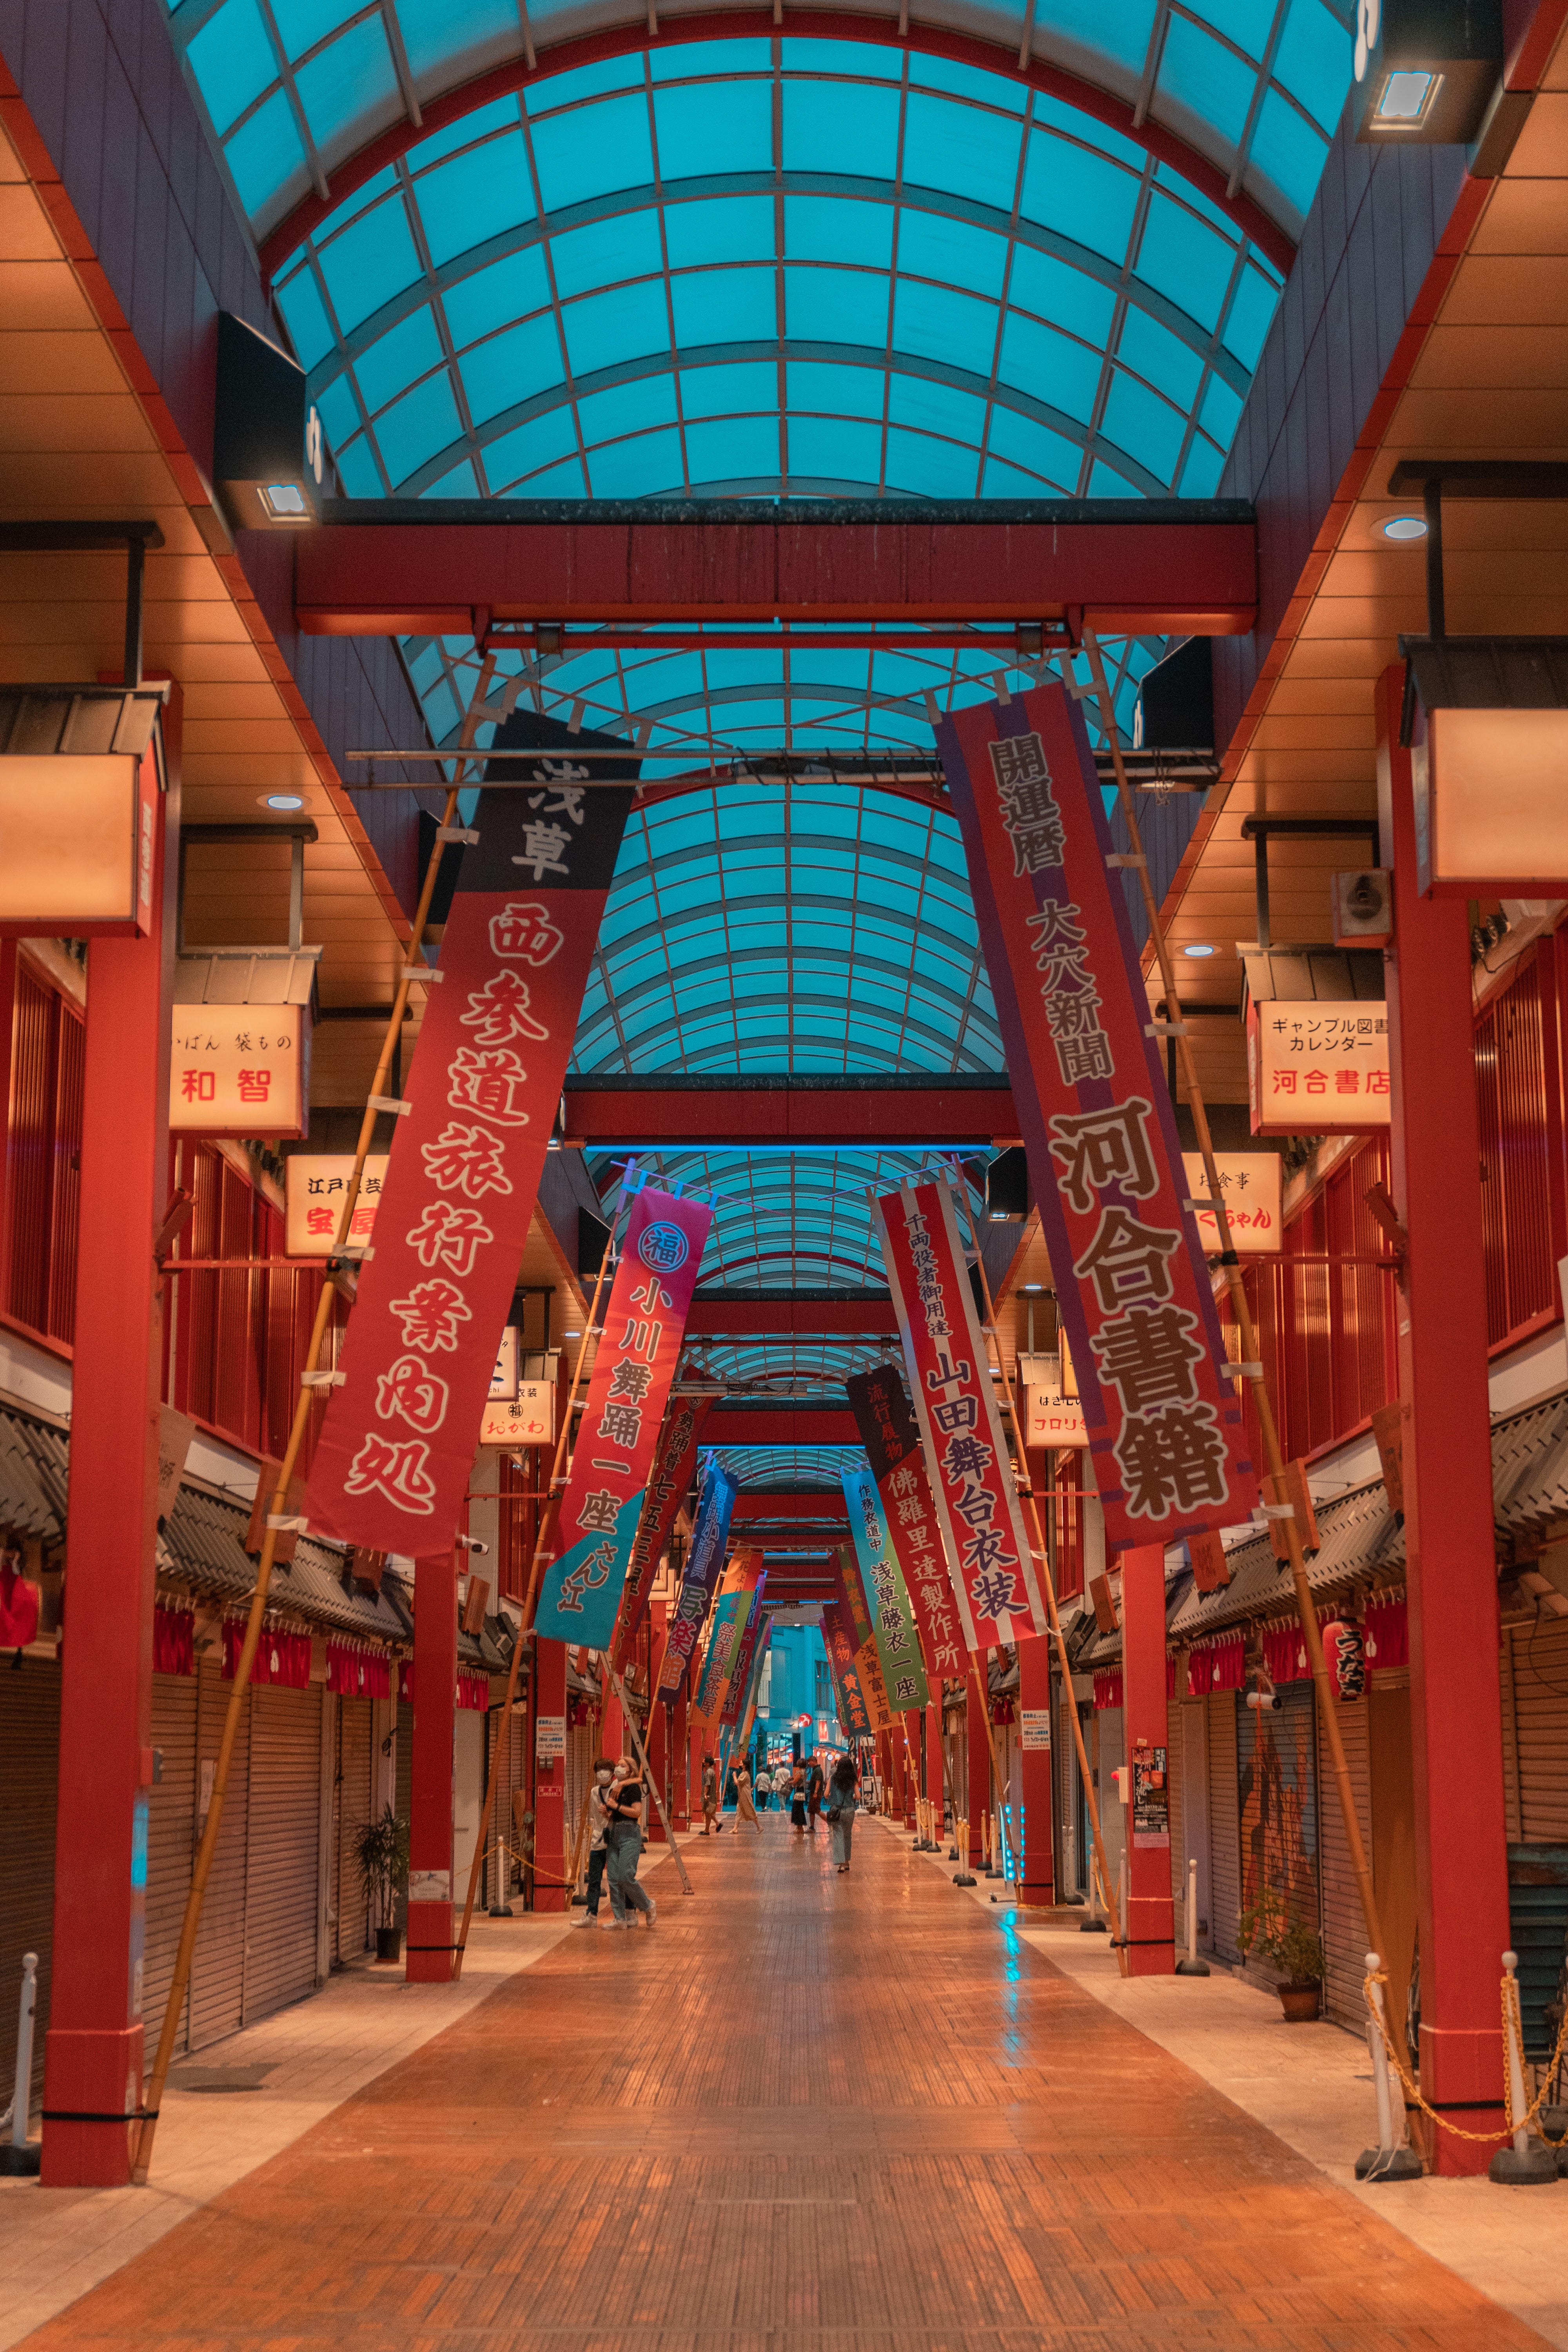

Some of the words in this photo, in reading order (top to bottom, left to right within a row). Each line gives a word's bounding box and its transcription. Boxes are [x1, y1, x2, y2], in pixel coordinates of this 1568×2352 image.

[512, 759, 589, 881] 浅草
[175, 1034, 220, 1051] ばん
[235, 1032, 291, 1051] 袋もの
[1026, 898, 1115, 1086] 大穴新聞
[1272, 1018, 1388, 1034] ギャンブル図書
[1290, 1036, 1373, 1051] カレンダー
[181, 1069, 270, 1102] 和智
[1273, 1069, 1390, 1094] 河合書店
[903, 1213, 953, 1338] 千両役者御用達
[1049, 1096, 1229, 1520] 河合書籍
[487, 1420, 544, 1434] おがわ
[577, 1277, 673, 1534] 小川舞踊一座
[662, 1410, 693, 1471] 舞踊着
[927, 1353, 1029, 1621] 山田舞台衣装
[888, 1468, 959, 1671] 佛羅里達製作所
[699, 1622, 737, 1716] 祭美食茶屋
[833, 1615, 850, 1662] 土産物
[842, 1673, 866, 1728] 黄金堂
[871, 1560, 919, 1700] 浅草藤衣一座
[860, 1644, 892, 1725] 浅草富士屋
